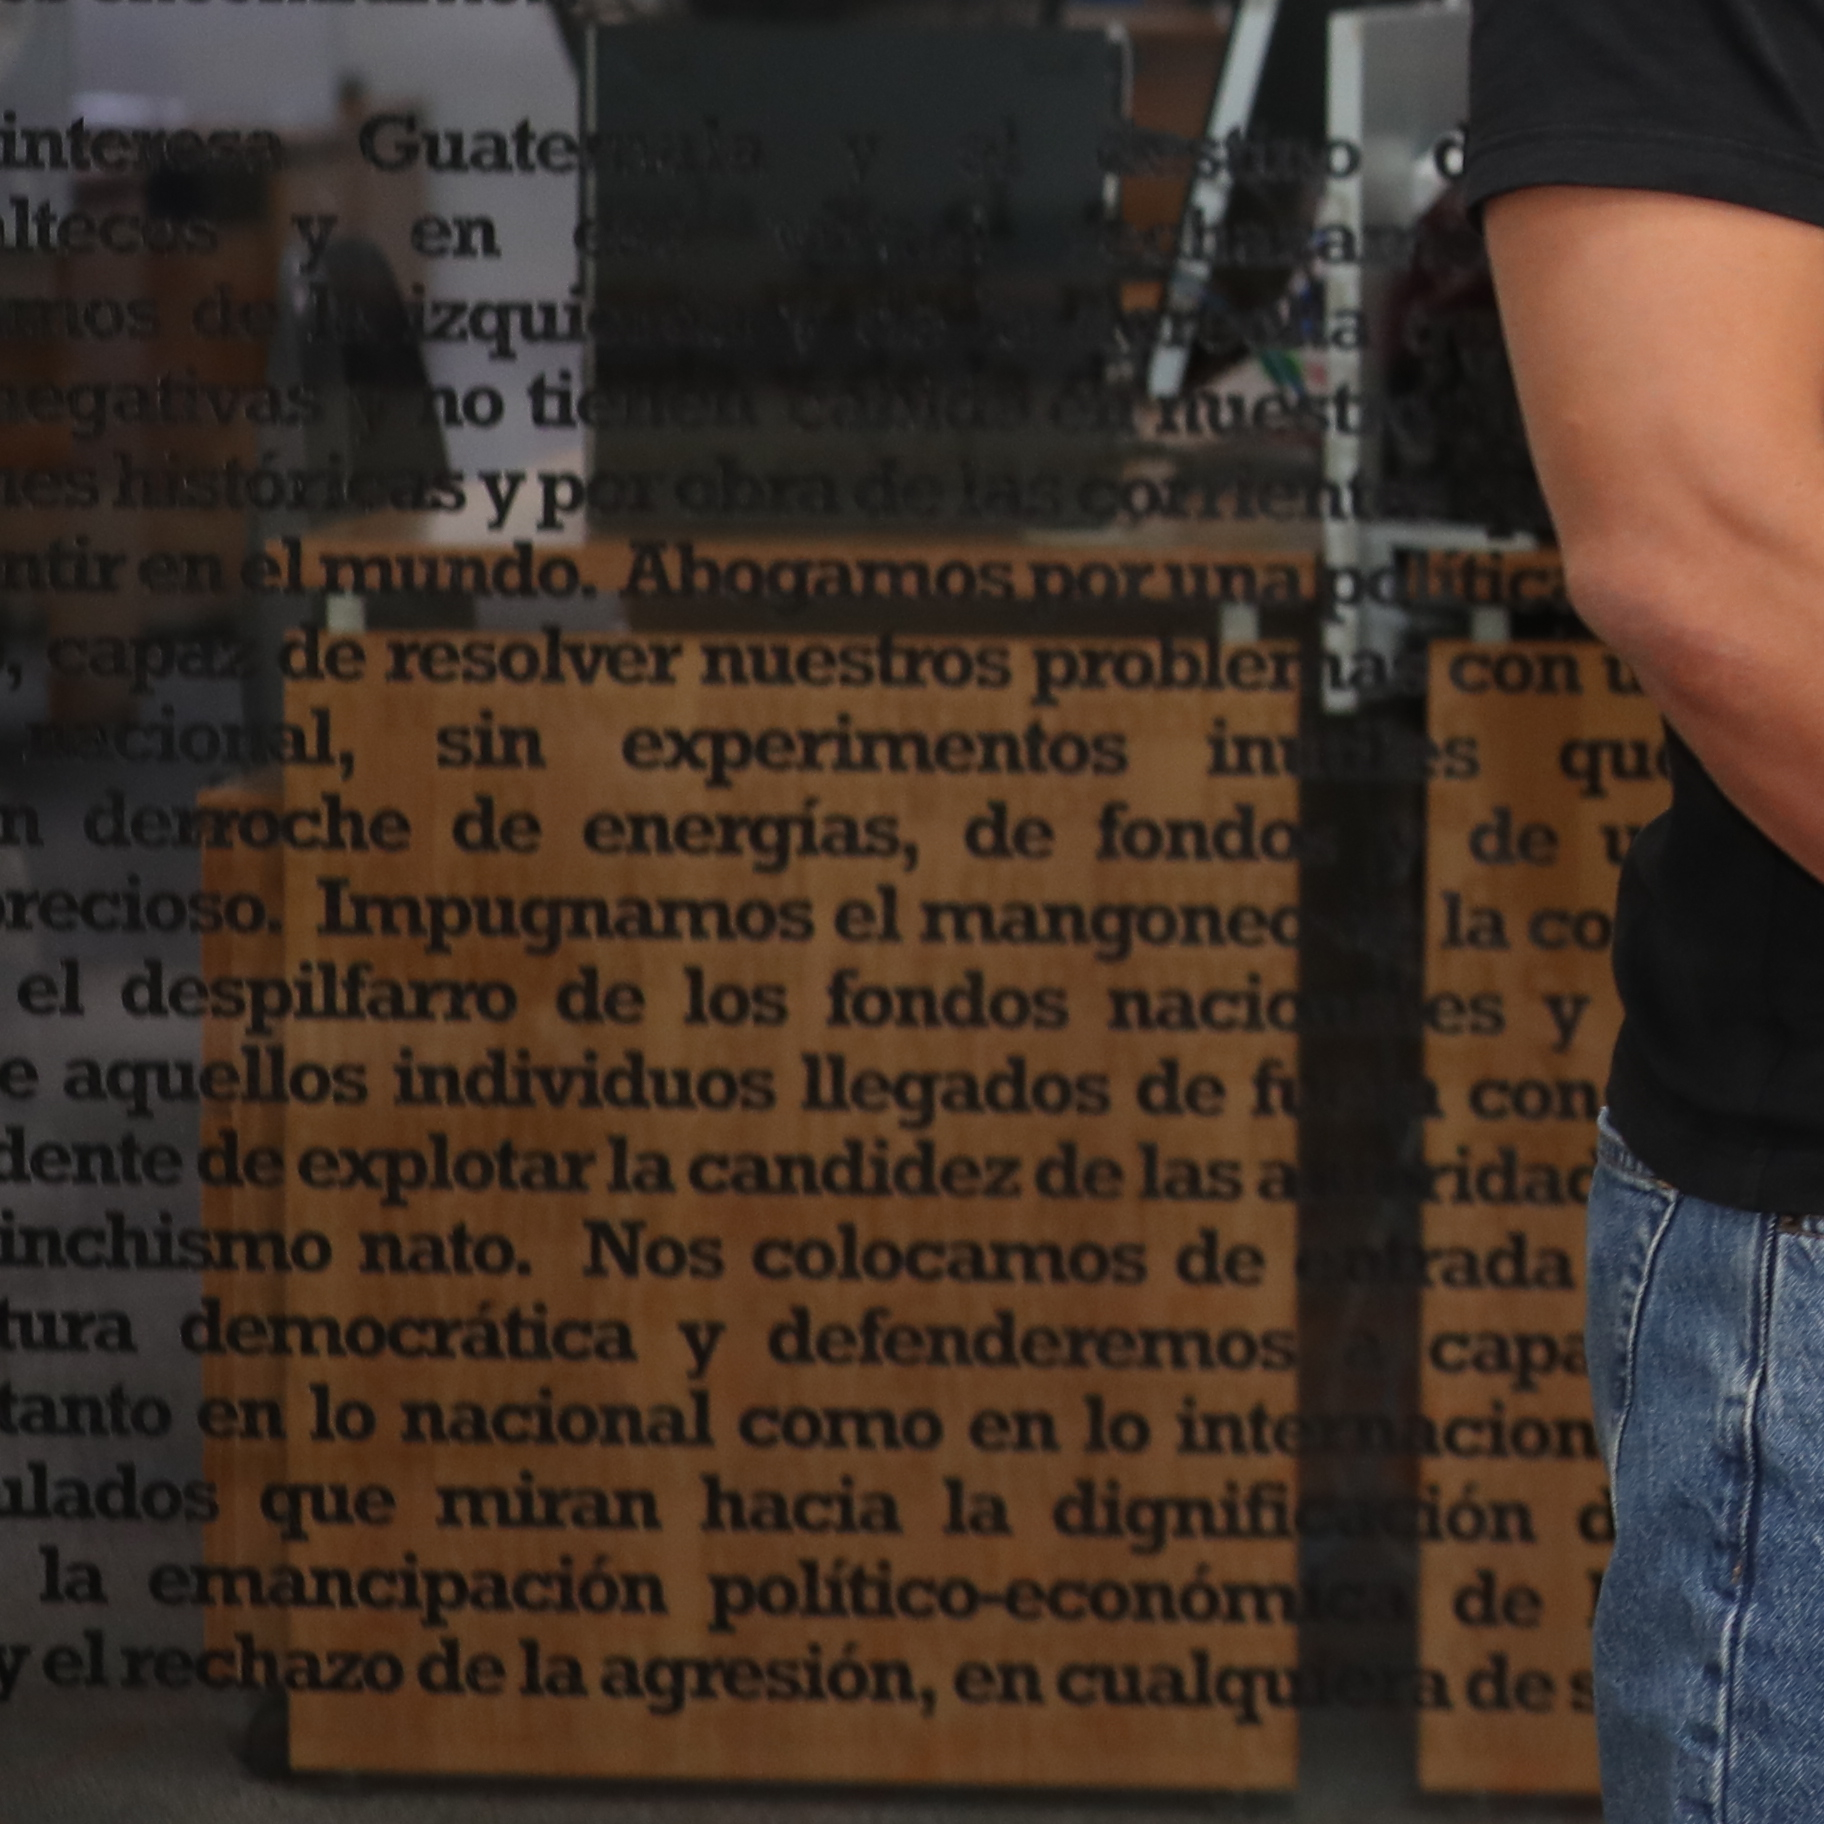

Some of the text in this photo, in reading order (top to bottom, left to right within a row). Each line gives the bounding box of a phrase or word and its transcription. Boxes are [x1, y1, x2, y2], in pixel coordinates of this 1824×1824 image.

[313, 541, 595, 604] mundo.
[386, 619, 682, 684] resolver
[437, 709, 1127, 789] sin experimentos
[85, 792, 918, 874] derroche energías,
[318, 873, 814, 957] Impugnamos
[122, 959, 1067, 1037] despilfarro los fondos
[64, 1044, 1598, 1131] aquellos individuos llegados con
[298, 1130, 1242, 1208] explotar candidez las
[361, 1219, 1146, 1284] nato. Nos colocamos
[180, 1296, 1293, 1371] democrática defenderemos
[402, 1387, 943, 1450] nacional como
[261, 1471, 901, 1543] que miran hacia
[150, 1552, 667, 1628] emancipación
[122, 1632, 936, 1717] rechazo agresión,
